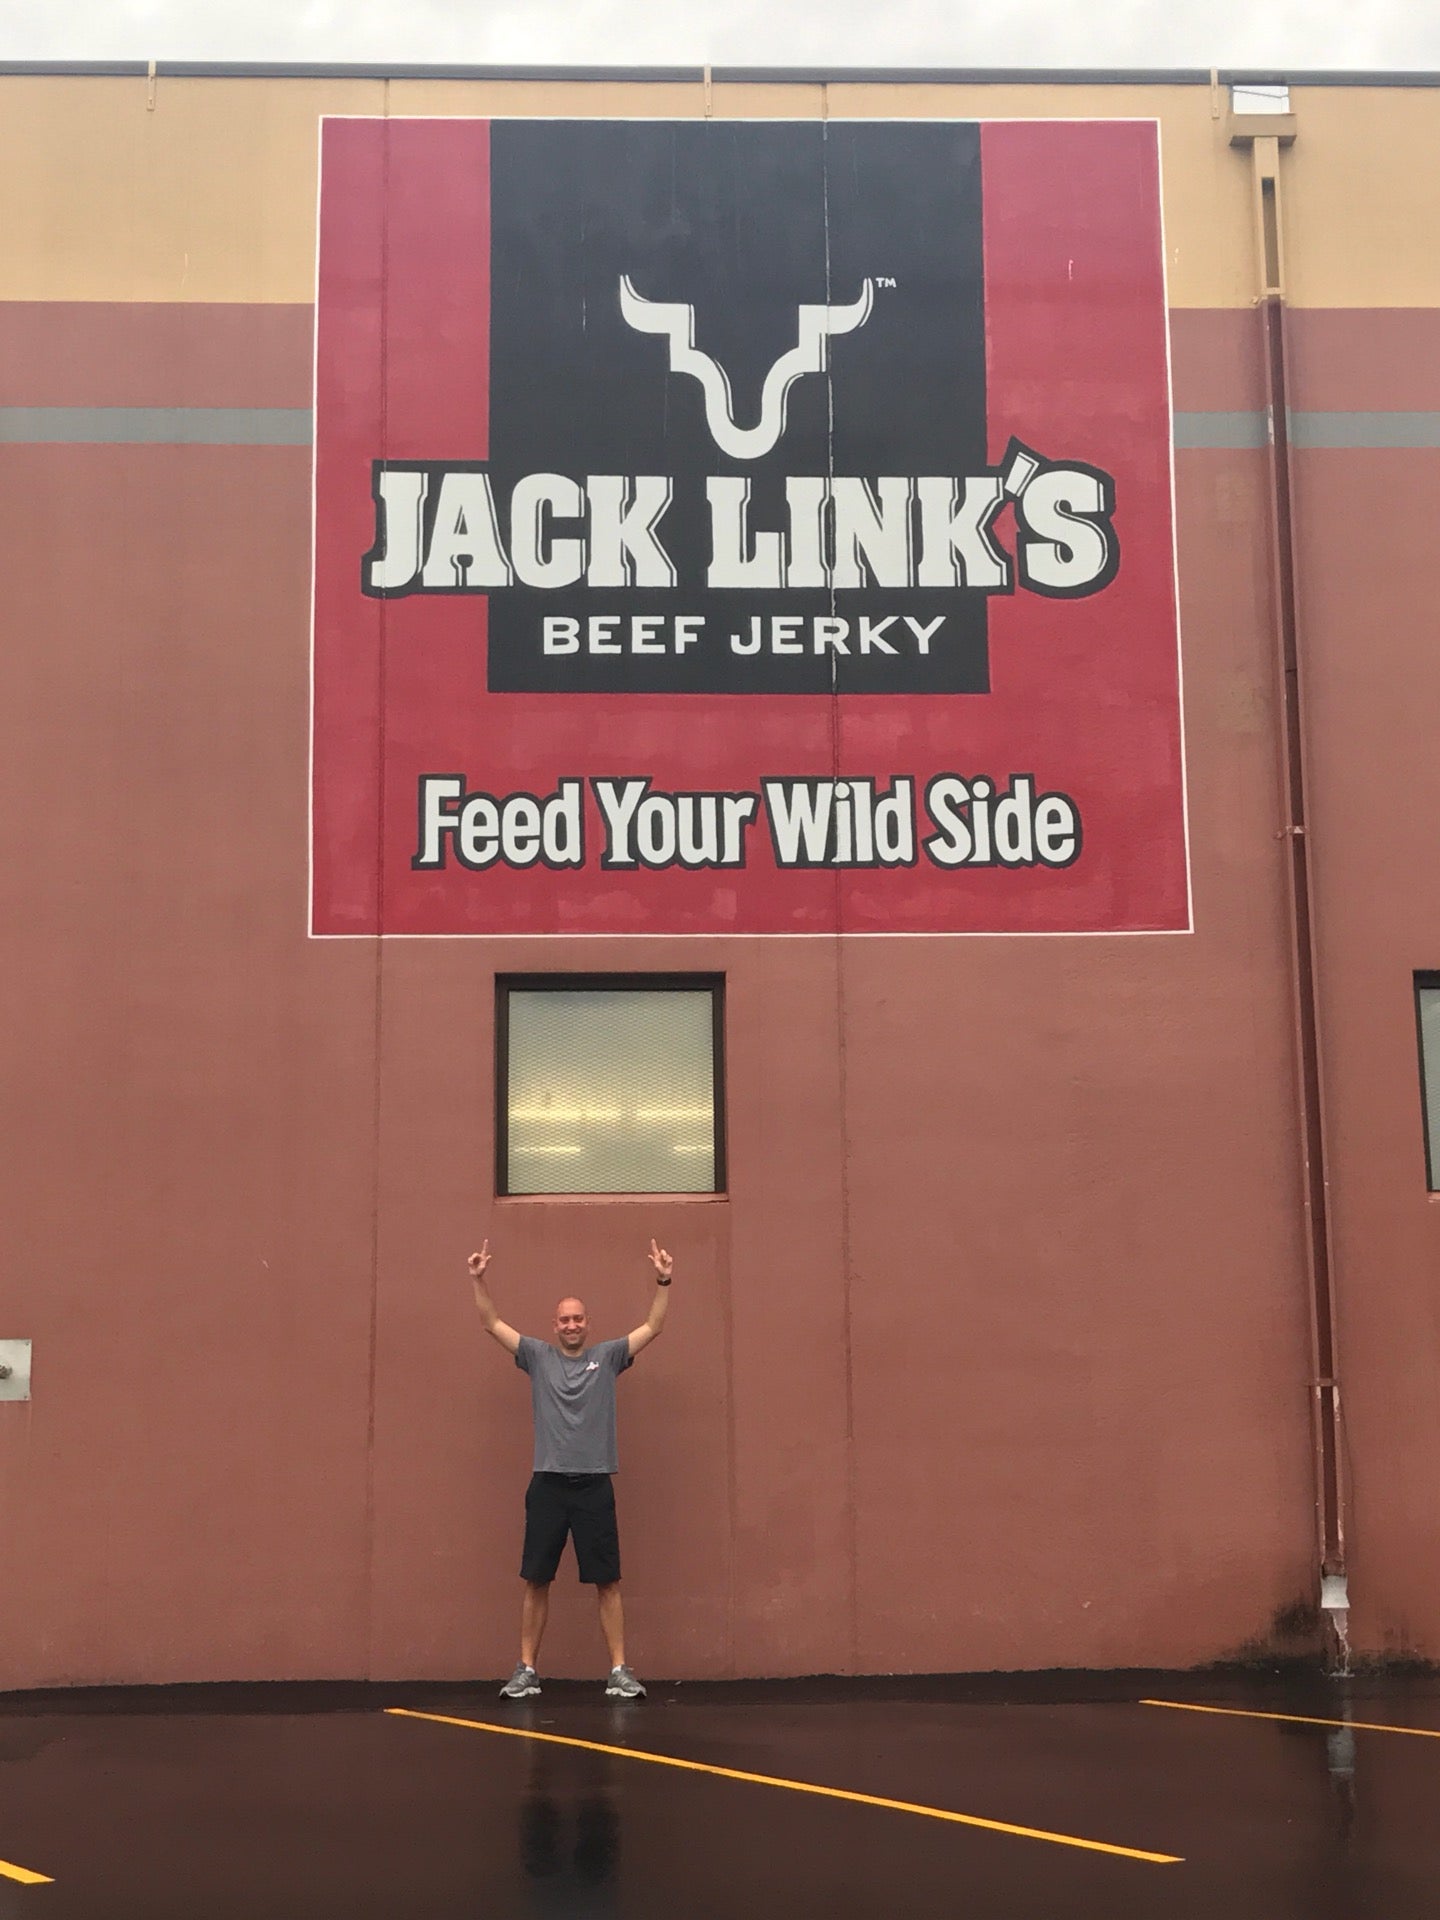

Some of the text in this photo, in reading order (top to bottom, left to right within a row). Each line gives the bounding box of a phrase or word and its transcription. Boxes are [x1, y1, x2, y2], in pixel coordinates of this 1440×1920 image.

[371, 452, 1108, 590] JACK LINK'S
[542, 615, 947, 655] BEEF JERKY
[419, 778, 1076, 864] Feed Your Wild Side
